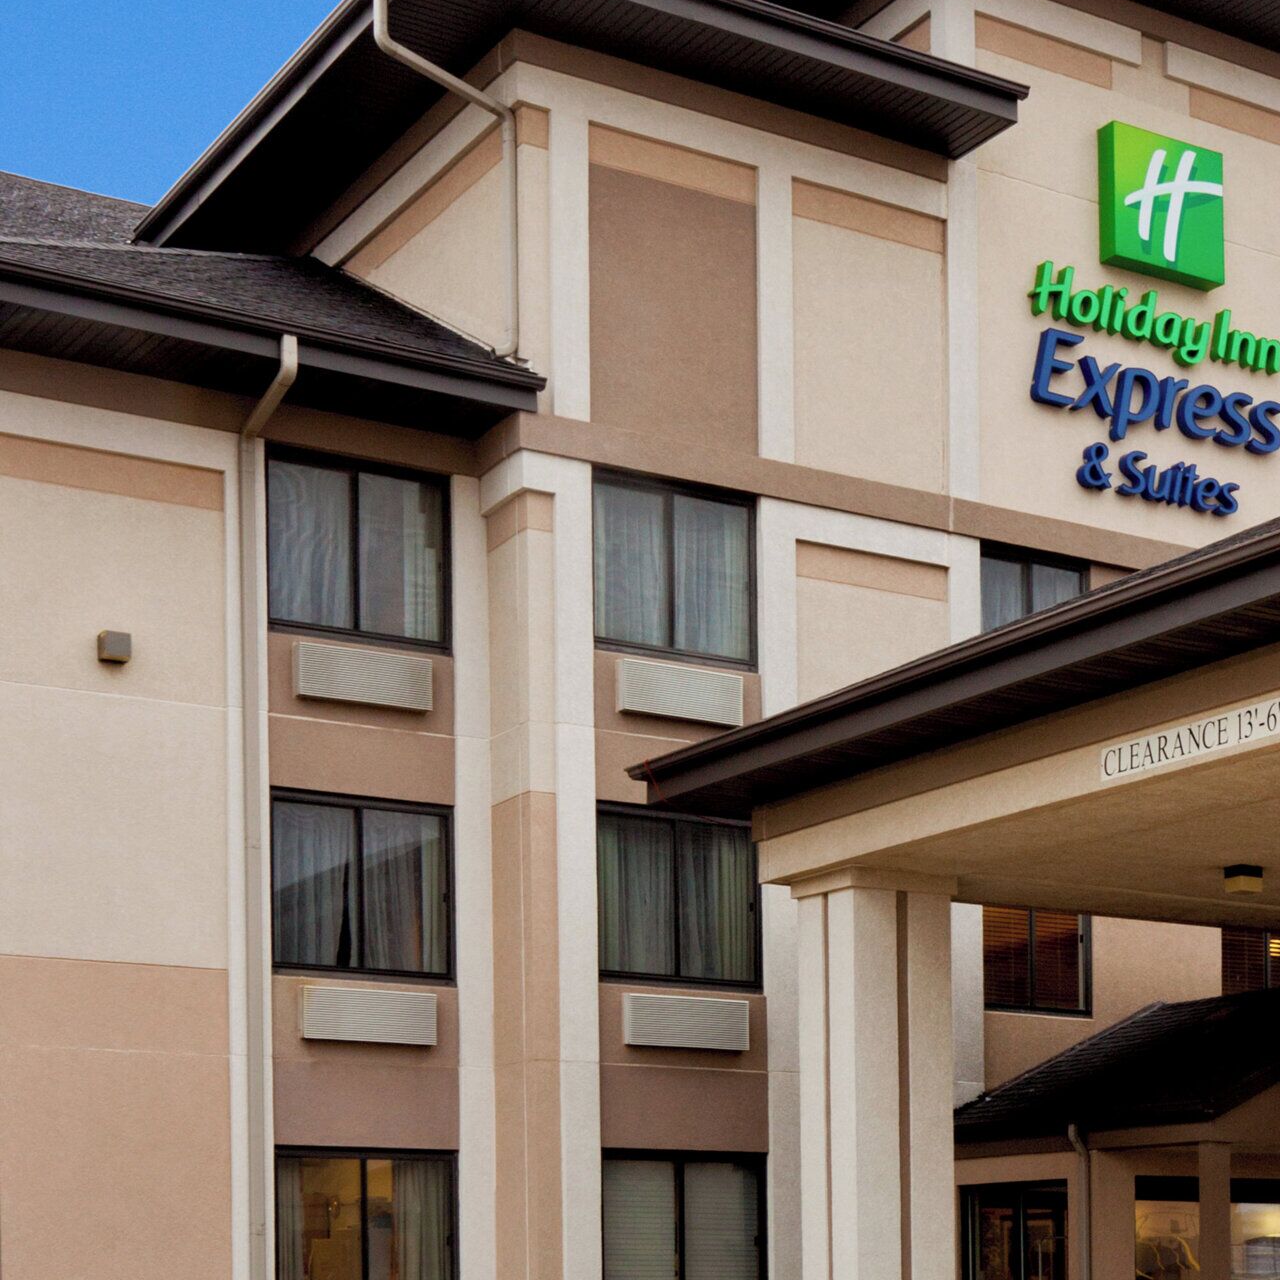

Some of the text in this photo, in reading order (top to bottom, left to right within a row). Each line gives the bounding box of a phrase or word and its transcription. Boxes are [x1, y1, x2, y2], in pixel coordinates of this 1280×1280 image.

[1029, 260, 1211, 367] Holiday
[1076, 442, 1241, 516] & Suites
[1103, 717, 1230, 776] CLEARANCE
